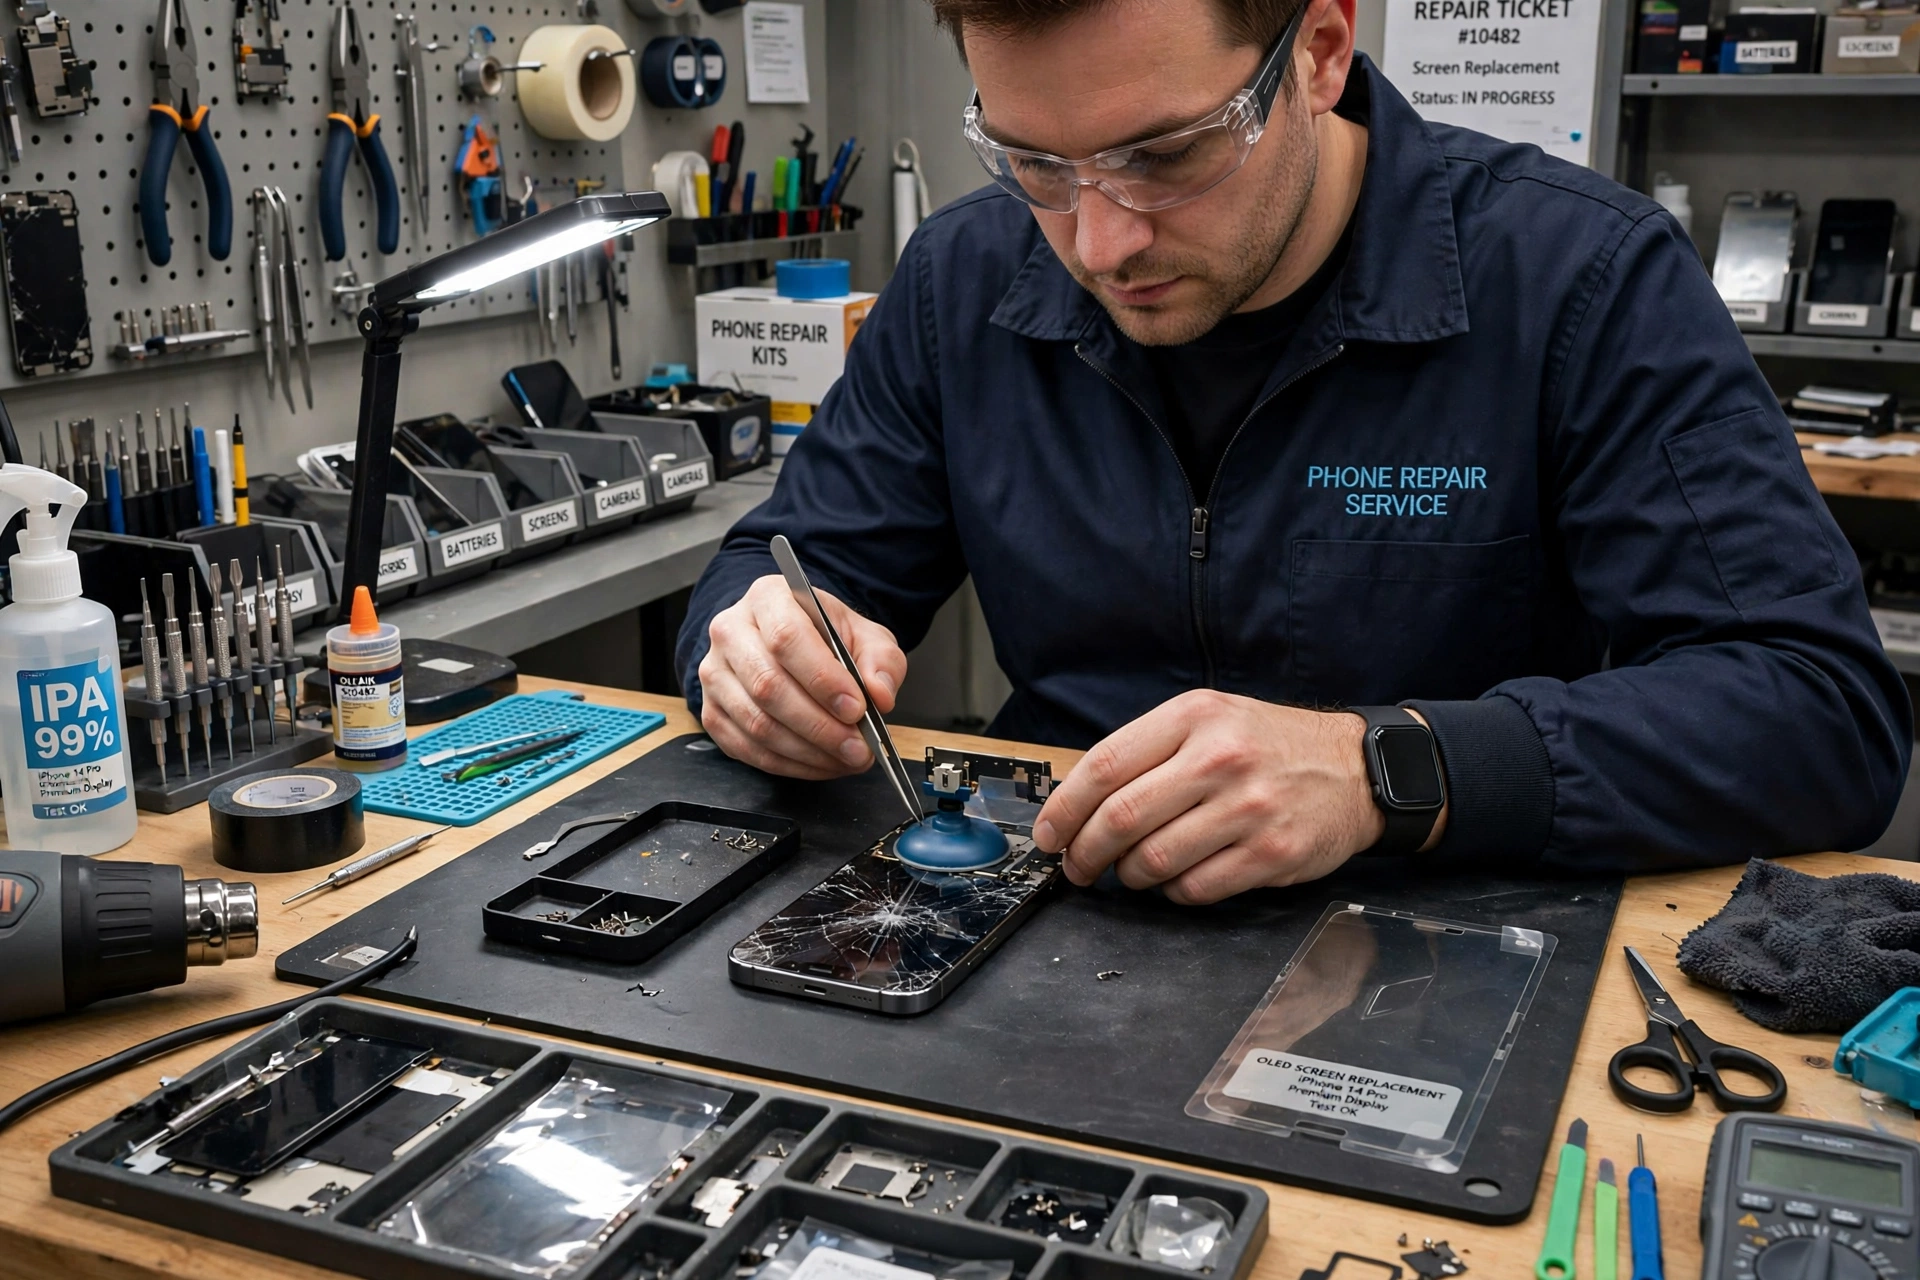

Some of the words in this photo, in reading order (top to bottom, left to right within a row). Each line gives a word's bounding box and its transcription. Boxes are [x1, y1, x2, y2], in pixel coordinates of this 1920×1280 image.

[1414, 1, 1490, 19] REPAIR
[1499, 0, 1573, 18] TICKET
[1458, 28, 1520, 44] #10482
[1412, 60, 1460, 75] Screen
[1465, 60, 1560, 77] Replacement
[1412, 91, 1458, 105] Status:
[1462, 91, 1477, 104] IN
[1481, 91, 1556, 105] PROGRESS
[712, 319, 765, 340] PHONE
[770, 322, 828, 343] REPAIR
[752, 346, 787, 366] KITS
[666, 468, 704, 489] CAMERAS
[1307, 466, 1393, 488] PHONE
[1400, 466, 1487, 489] REPAIR
[600, 488, 641, 510] CAMERAS
[1345, 493, 1448, 516] SERVICE
[528, 509, 569, 532] SCREENS
[446, 531, 497, 559] BATTERIES
[29, 675, 109, 722] IPA
[34, 716, 114, 759] 99%
[86, 765, 101, 774] Pro
[70, 802, 87, 814] OK
[1256, 1056, 1292, 1069] OLED
[1294, 1064, 1345, 1081] SCREEN
[1348, 1074, 1447, 1100] REPLACEMENT
[1298, 1075, 1342, 1091] iPhone
[1348, 1086, 1363, 1095] 14
[1366, 1089, 1388, 1099] Pro
[1288, 1084, 1342, 1102] Premium
[1345, 1095, 1389, 1112] Display
[1310, 1100, 1336, 1111] Test
[1340, 1106, 1358, 1117] OK
